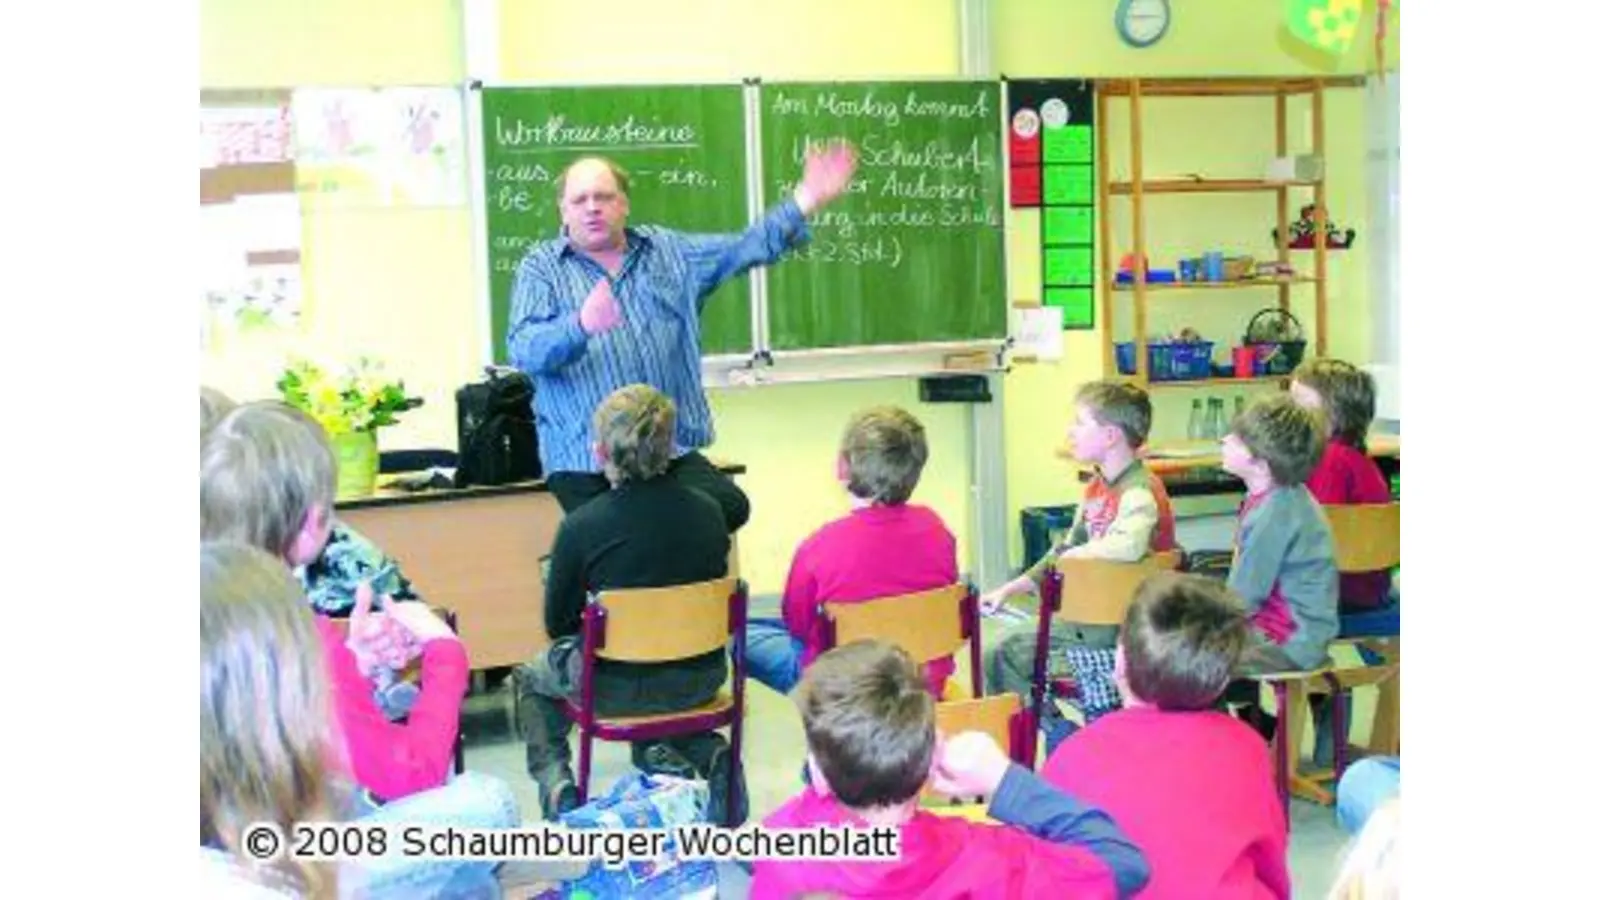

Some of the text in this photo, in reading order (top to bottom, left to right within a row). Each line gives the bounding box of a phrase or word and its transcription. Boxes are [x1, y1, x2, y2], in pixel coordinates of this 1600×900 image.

[771, 91, 990, 126] Am Montag kommt
